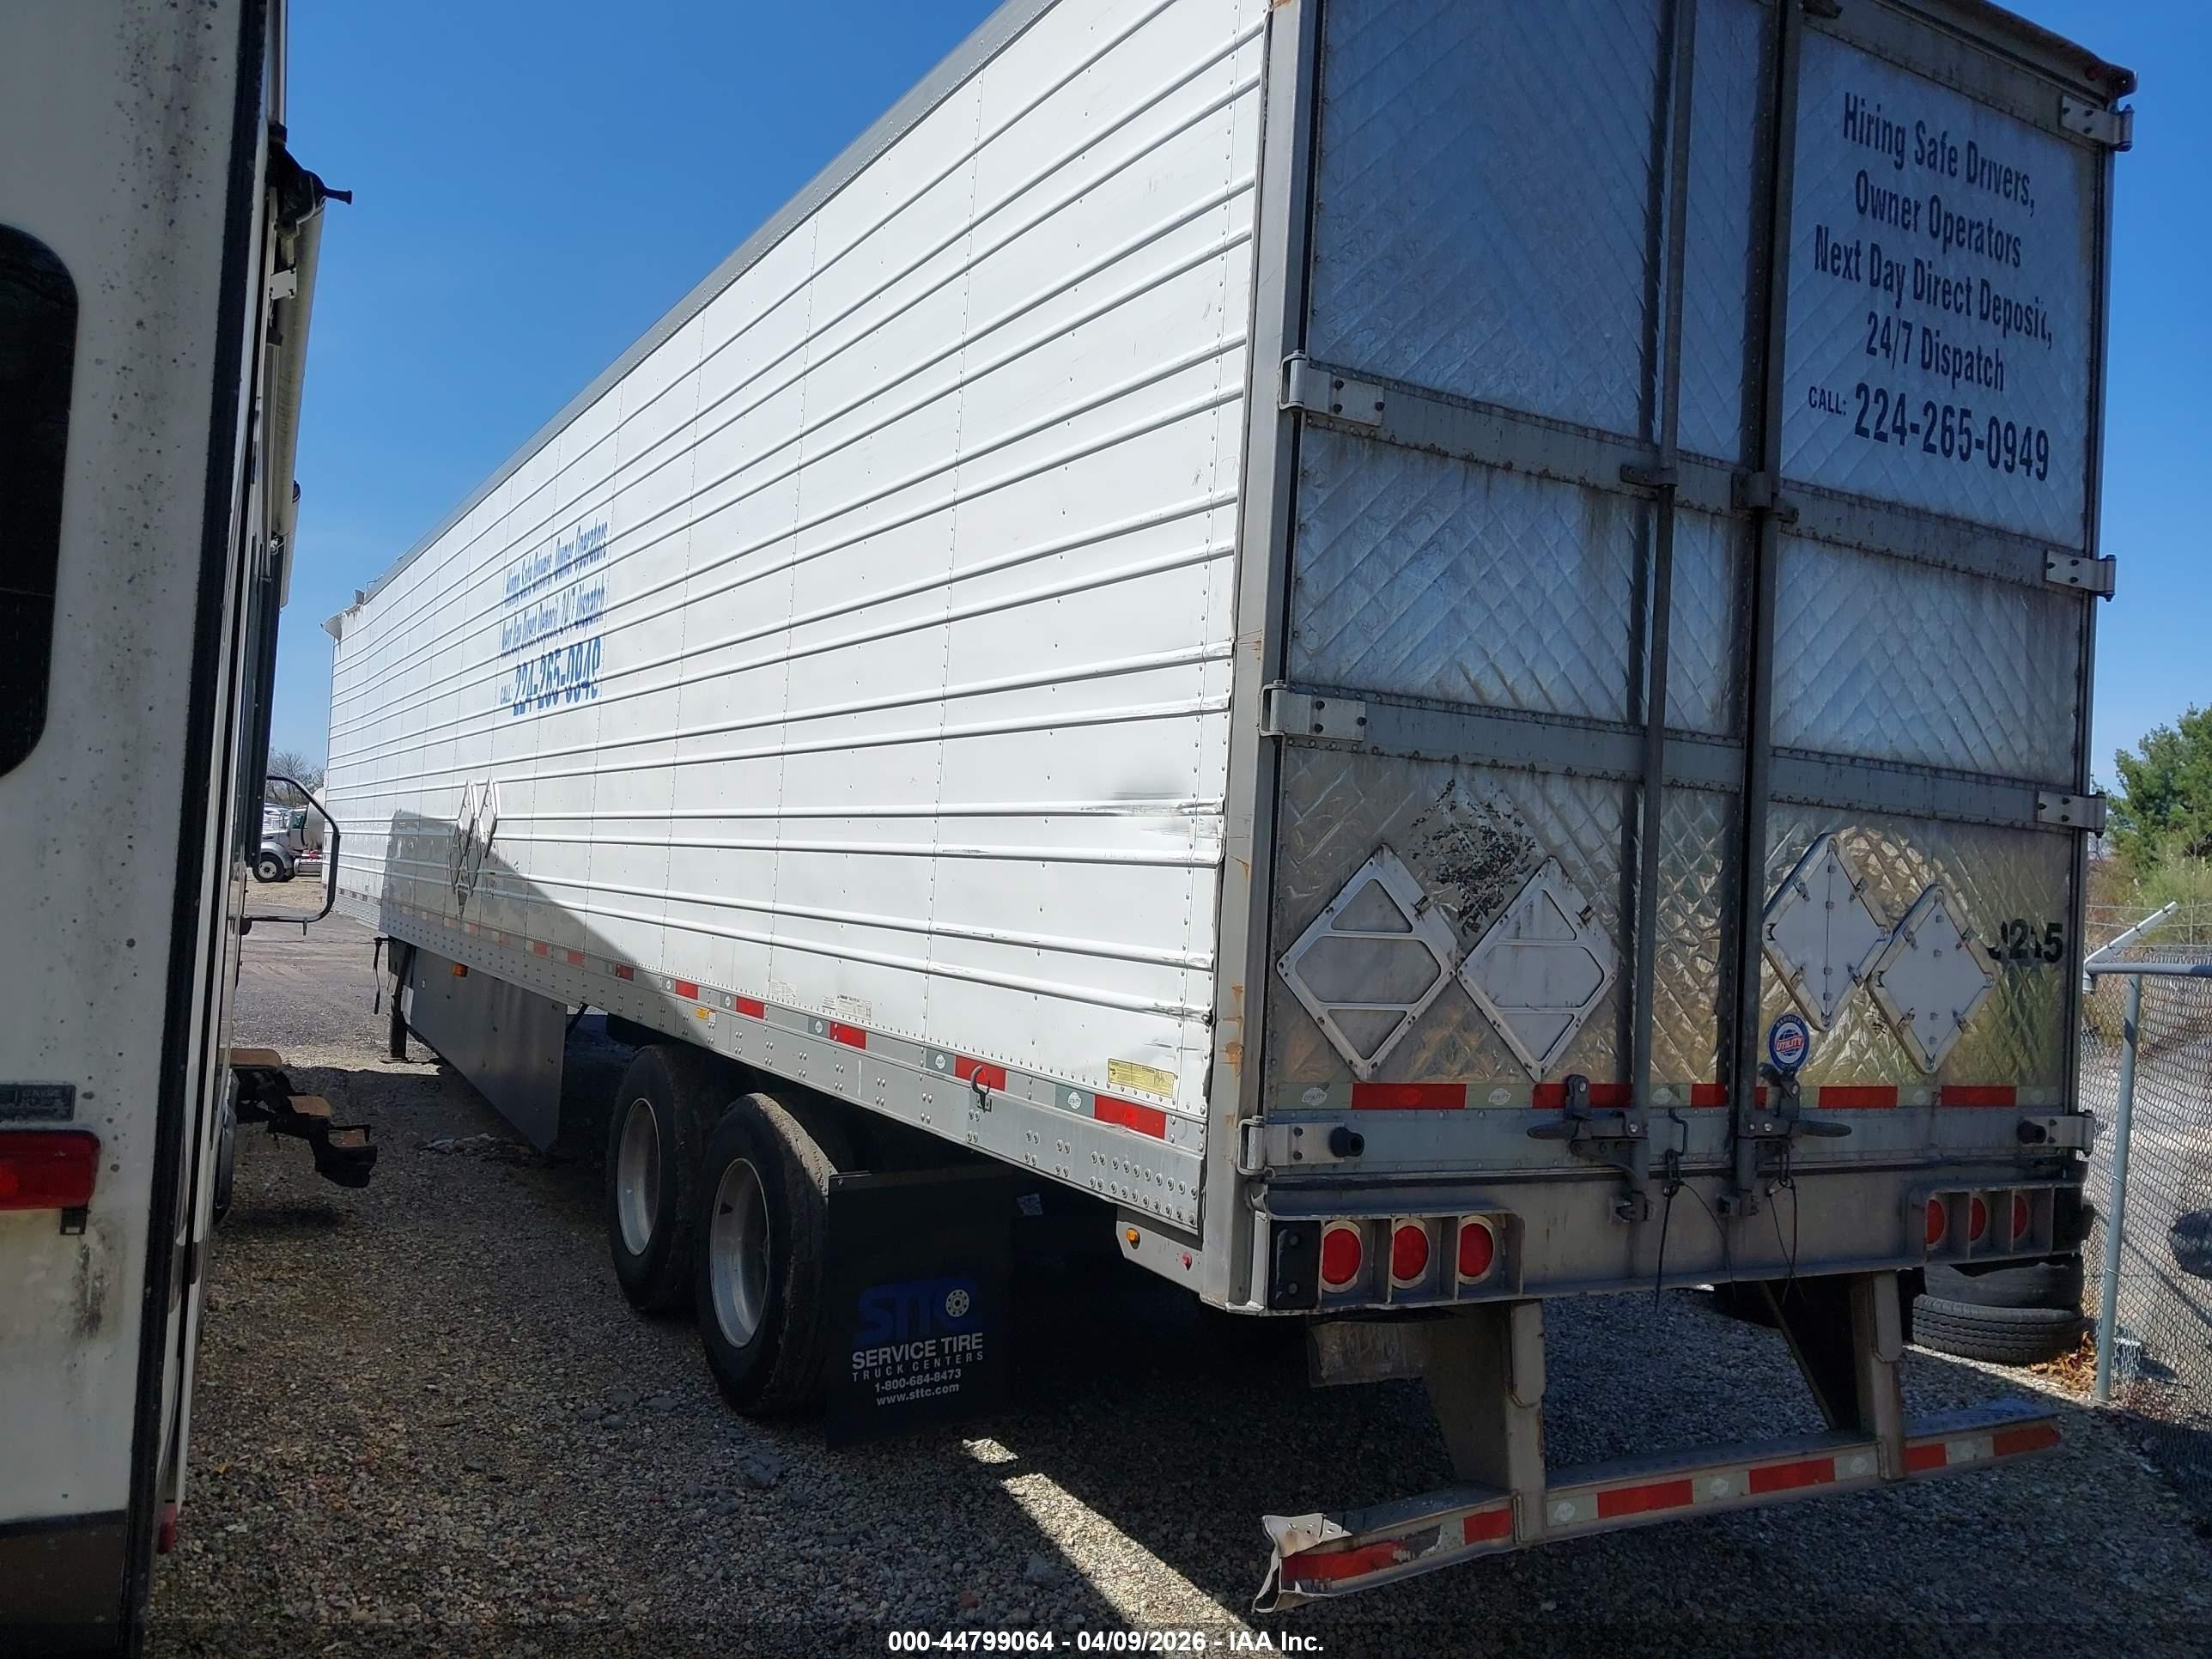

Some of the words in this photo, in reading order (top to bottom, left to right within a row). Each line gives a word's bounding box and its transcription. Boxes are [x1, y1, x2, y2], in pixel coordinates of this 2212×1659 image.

[1843, 92, 1906, 170] Hiring
[1914, 119, 1959, 178] Safe
[1966, 140, 2035, 217] Drivers,
[1855, 169, 1922, 232] Owner
[1929, 194, 2021, 268] Operators
[1814, 224, 1862, 283] Next
[1869, 242, 1906, 309] Day
[1913, 258, 1972, 316] Direct
[1865, 311, 1913, 369] 24/7
[1921, 326, 2004, 392] Dispatch
[1808, 386, 1847, 416] CALL:
[1855, 382, 2049, 482] 224-265-0949
[1777, 1037, 1803, 1051] UTILITY
[852, 1340, 936, 1370] SERVICE
[940, 1333, 983, 1354] TIRE
[852, 1364, 904, 1382] TRUCK
[912, 1351, 983, 1372] CENTERS
[874, 1368, 962, 1393] 1-800-684-8473
[876, 1383, 960, 1407] www.sttc.com
